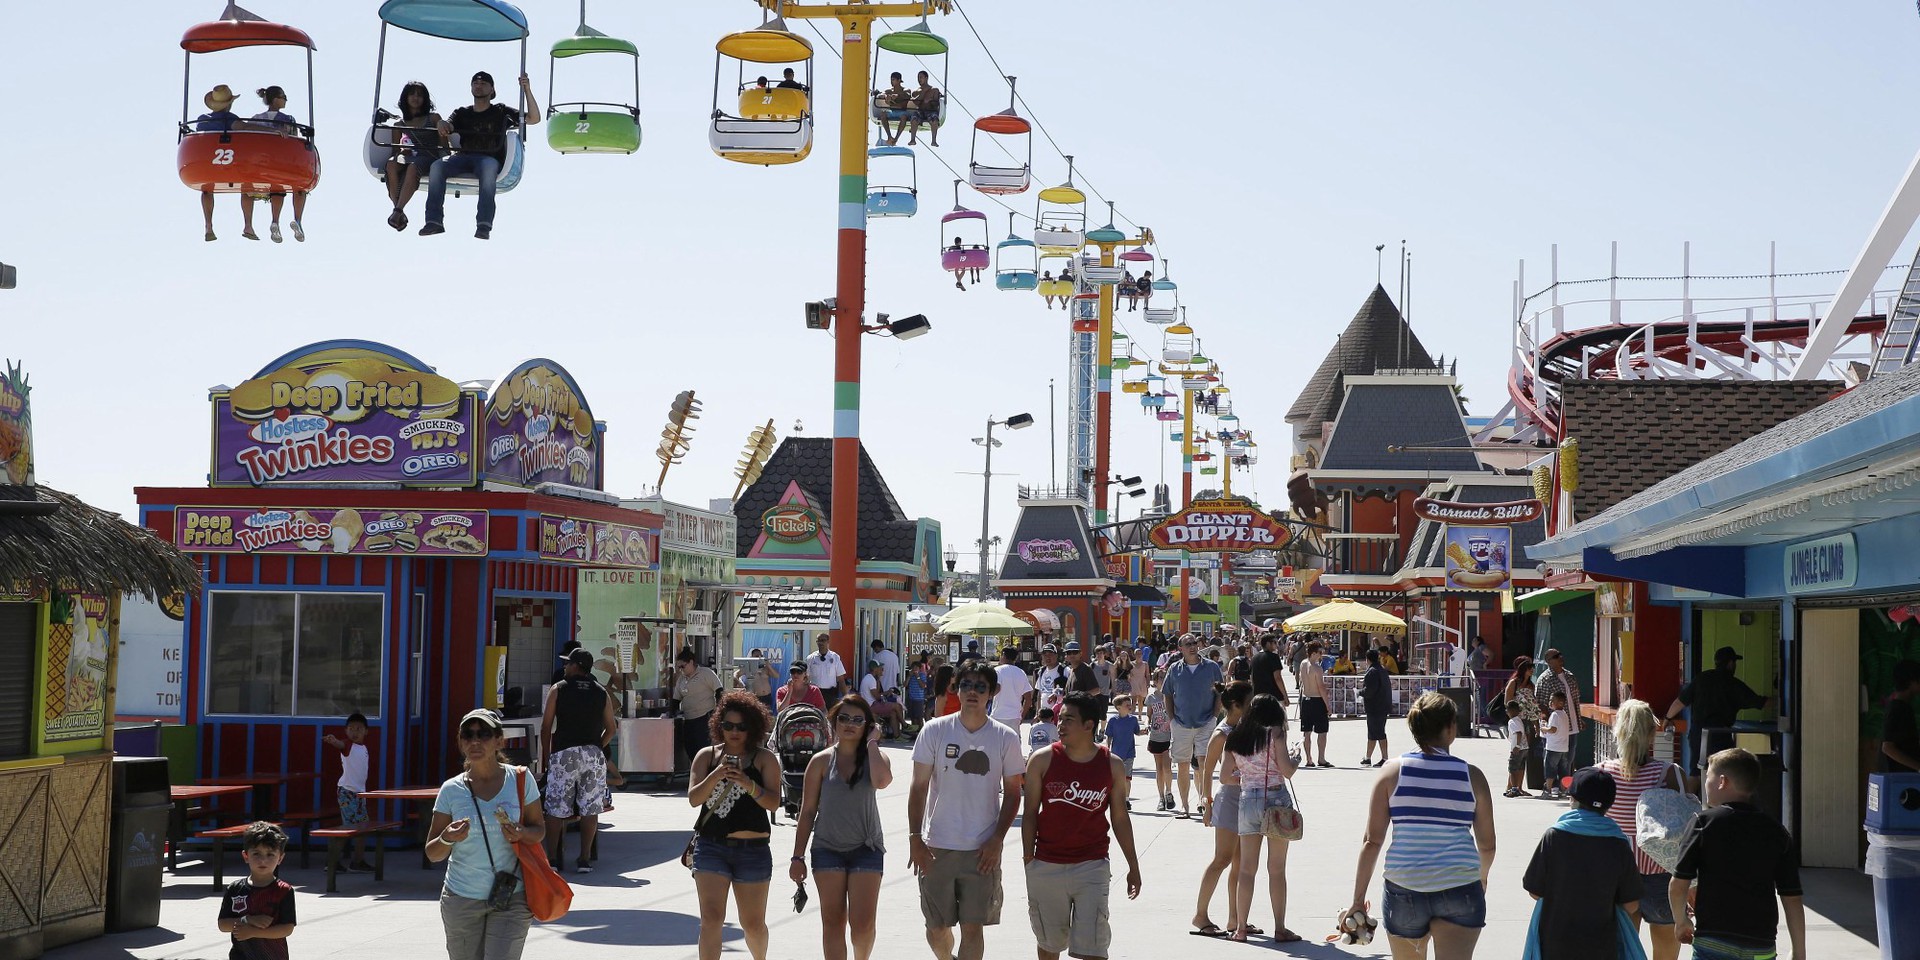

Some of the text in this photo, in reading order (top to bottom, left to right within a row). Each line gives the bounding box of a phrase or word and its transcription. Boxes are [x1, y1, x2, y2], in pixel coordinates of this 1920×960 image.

[850, 22, 857, 30] 2
[762, 96, 773, 104] 21
[574, 123, 590, 133] 22
[212, 149, 234, 165] 23
[0, 381, 22, 412] hip
[272, 380, 421, 412] Deep Fried
[523, 377, 545, 413] Deep
[261, 416, 327, 442] Hostess
[403, 419, 461, 437] SMUCKER'S
[239, 430, 394, 484] Twinkies
[519, 433, 567, 484] Twinkies
[250, 513, 290, 525] Hostess
[434, 515, 471, 525] SMUCKER'S
[1187, 513, 1251, 525] GIANT
[1427, 504, 1534, 519] Barnacle Bill's
[186, 512, 232, 532] Deep
[366, 519, 405, 534] OREO
[677, 512, 723, 547] TATER TWISTS
[766, 510, 816, 532] Tickets
[184, 529, 233, 545] Fried
[237, 520, 331, 552] Twinkies
[1166, 525, 1274, 543] DIPPER
[557, 533, 586, 555] Twinkies
[1105, 563, 1126, 577] KES
[1791, 542, 1844, 586] JUNGLE CLIMB
[584, 572, 598, 583] IT.
[603, 572, 635, 584] LOVE
[639, 572, 656, 584] IT!
[83, 599, 106, 616] Whip
[1323, 622, 1400, 634] Face Painting
[46, 712, 99, 730] SWEET POTATO FRIES
[1063, 781, 1108, 805] Supply
